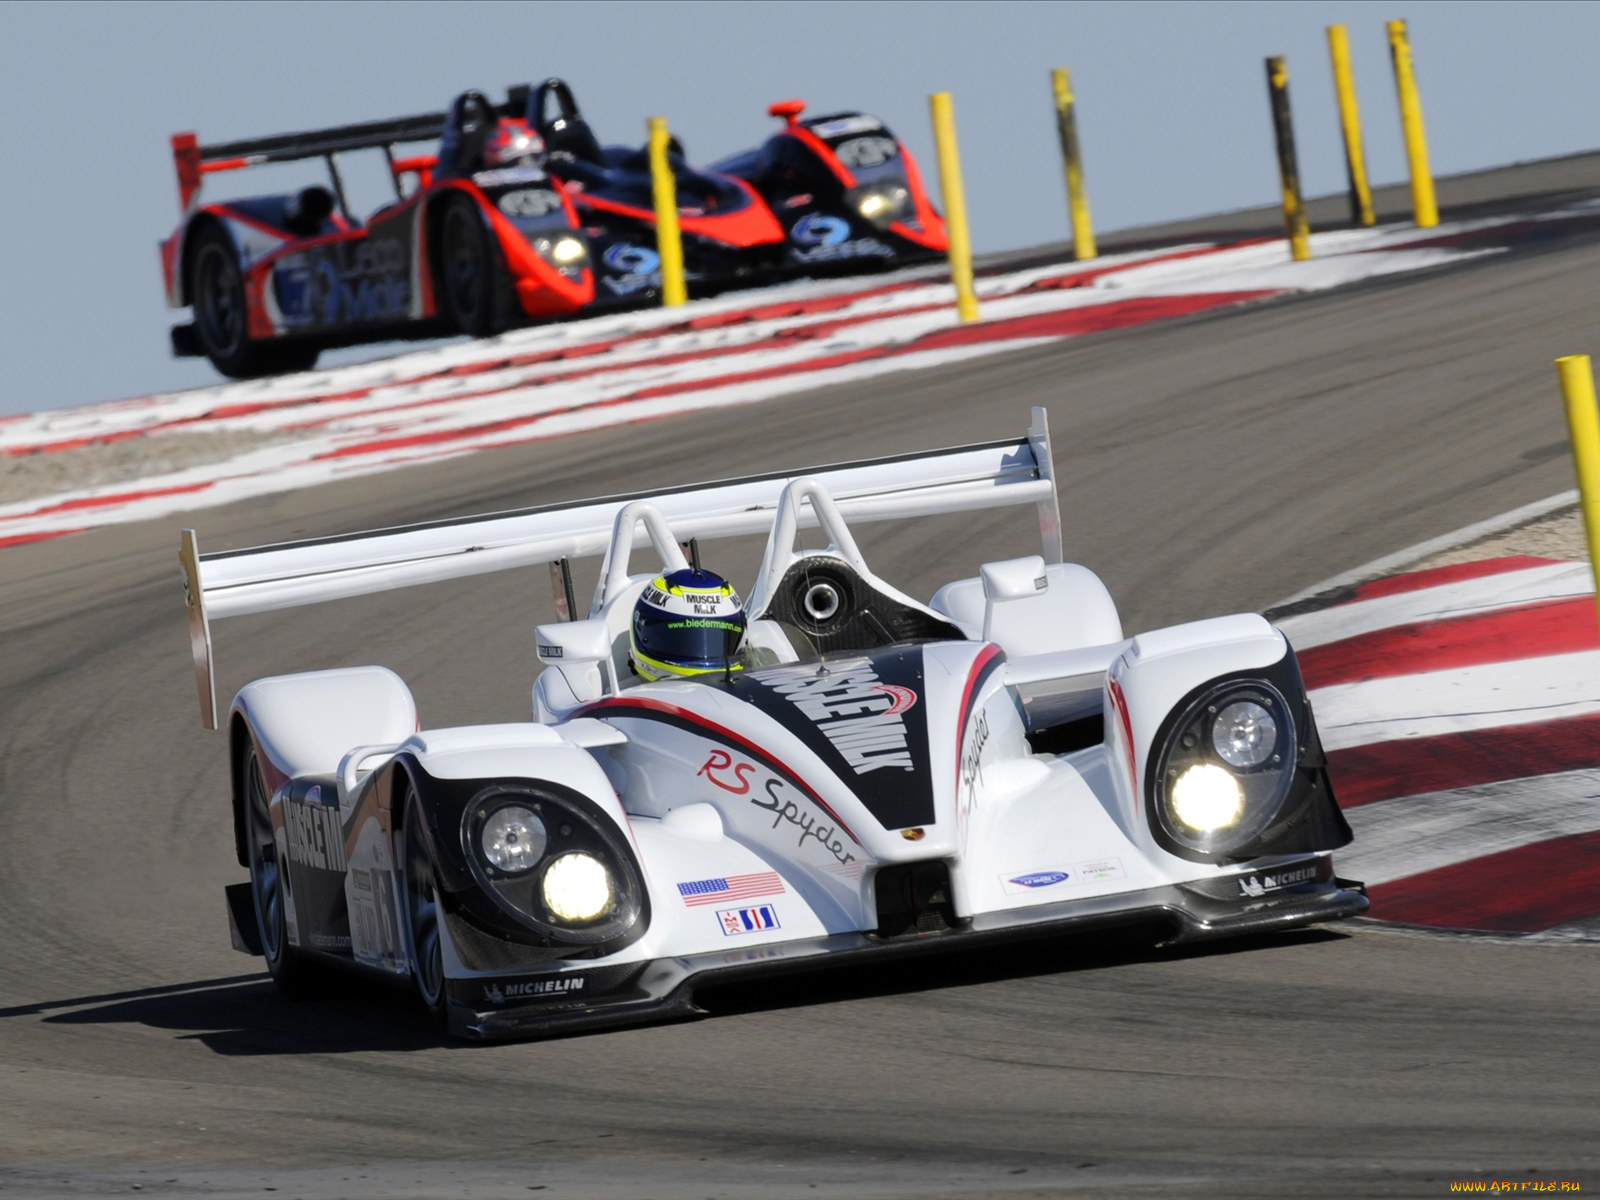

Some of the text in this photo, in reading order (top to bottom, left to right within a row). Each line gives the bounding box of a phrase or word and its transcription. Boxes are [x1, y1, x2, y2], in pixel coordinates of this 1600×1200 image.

[686, 594, 721, 605] MUSCLE
[816, 713, 915, 775] MILK
[697, 749, 857, 865] RS Spyder
[1264, 866, 1317, 888] MICHELIN
[505, 977, 584, 996] MICHELIN
